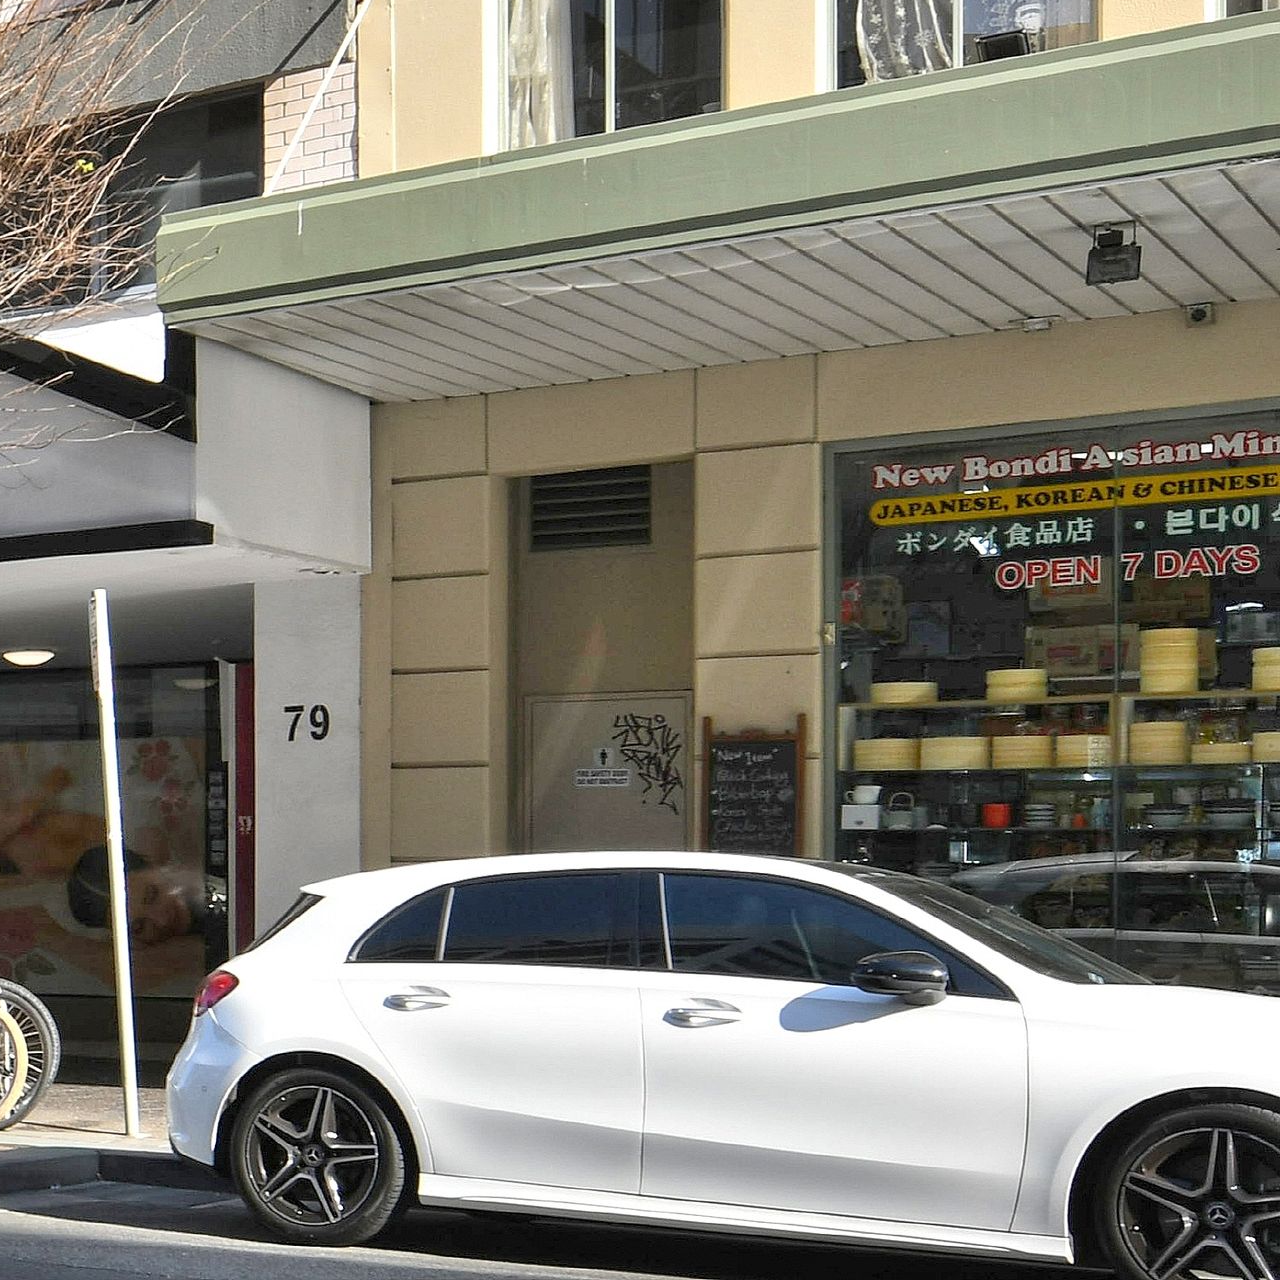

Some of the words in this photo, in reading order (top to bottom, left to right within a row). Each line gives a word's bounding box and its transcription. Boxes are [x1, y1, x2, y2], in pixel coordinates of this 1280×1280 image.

[872, 462, 955, 490] New
[962, 448, 1073, 483] Bondi
[877, 496, 1009, 520] JAPANESE,
[1015, 484, 1125, 509] KOREAN
[1133, 483, 1153, 498] &
[1160, 472, 1278, 495] CHINESE
[995, 555, 1102, 590] OPEN
[1121, 552, 1144, 582] 7
[1154, 544, 1261, 580] DAYS
[284, 704, 330, 742] 79
